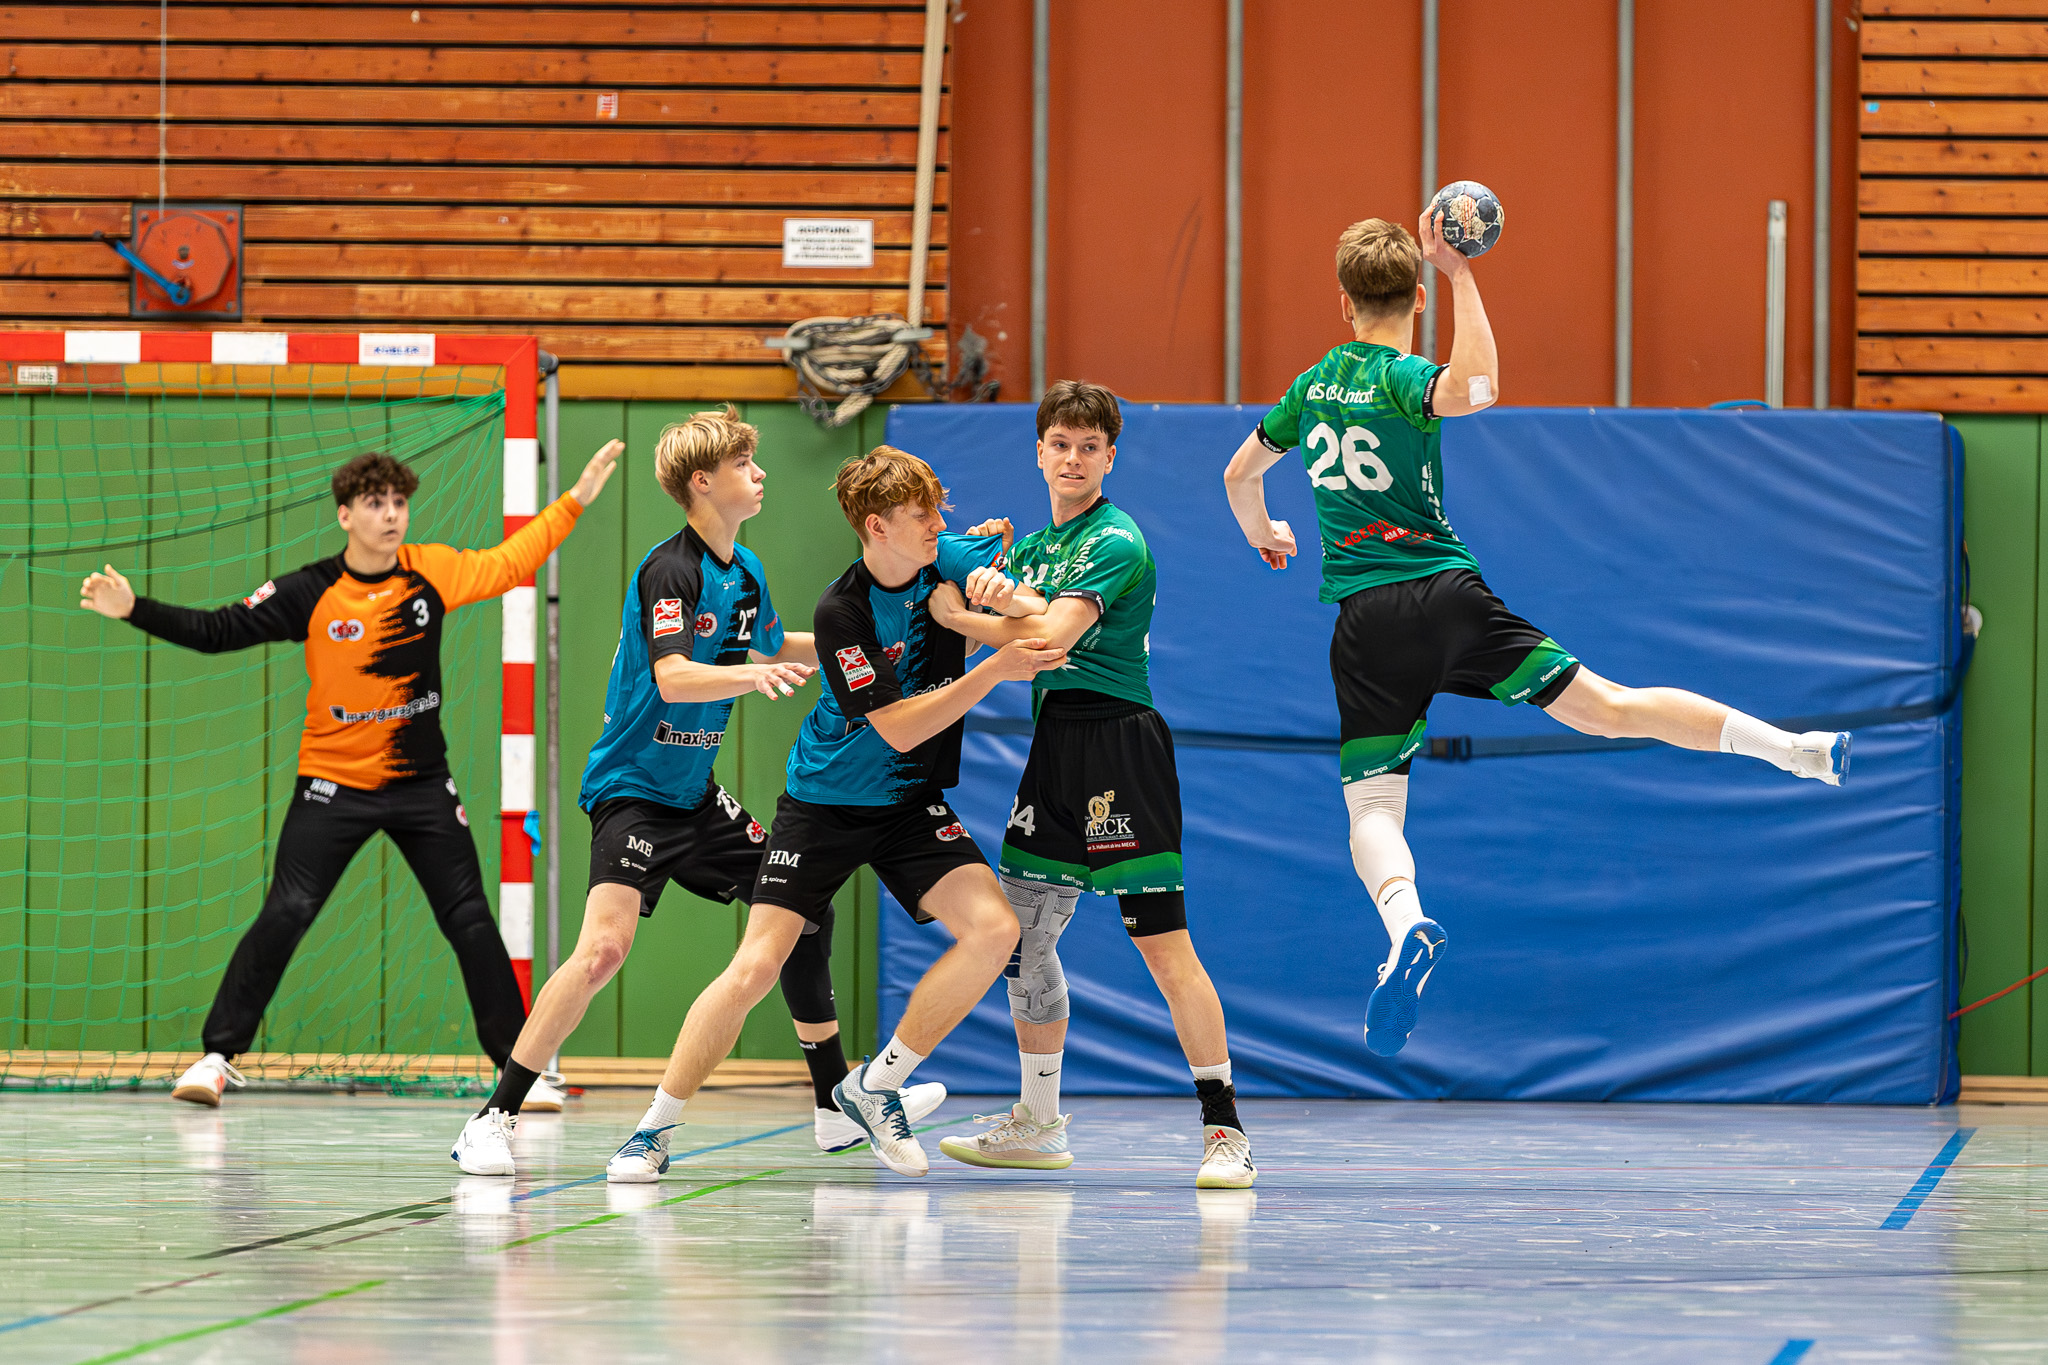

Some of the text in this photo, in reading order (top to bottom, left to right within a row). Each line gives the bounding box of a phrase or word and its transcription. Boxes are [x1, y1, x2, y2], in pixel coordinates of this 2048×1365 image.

[1306, 421, 1394, 493] 26
[412, 598, 430, 627] 3
[738, 606, 758, 640] 27
[1540, 665, 1561, 682] Kempa
[1399, 742, 1420, 760] Kempa
[1363, 765, 1388, 777] Kempa
[626, 835, 653, 857] MB
[767, 850, 801, 868] HM
[1023, 870, 1047, 880] Kempa
